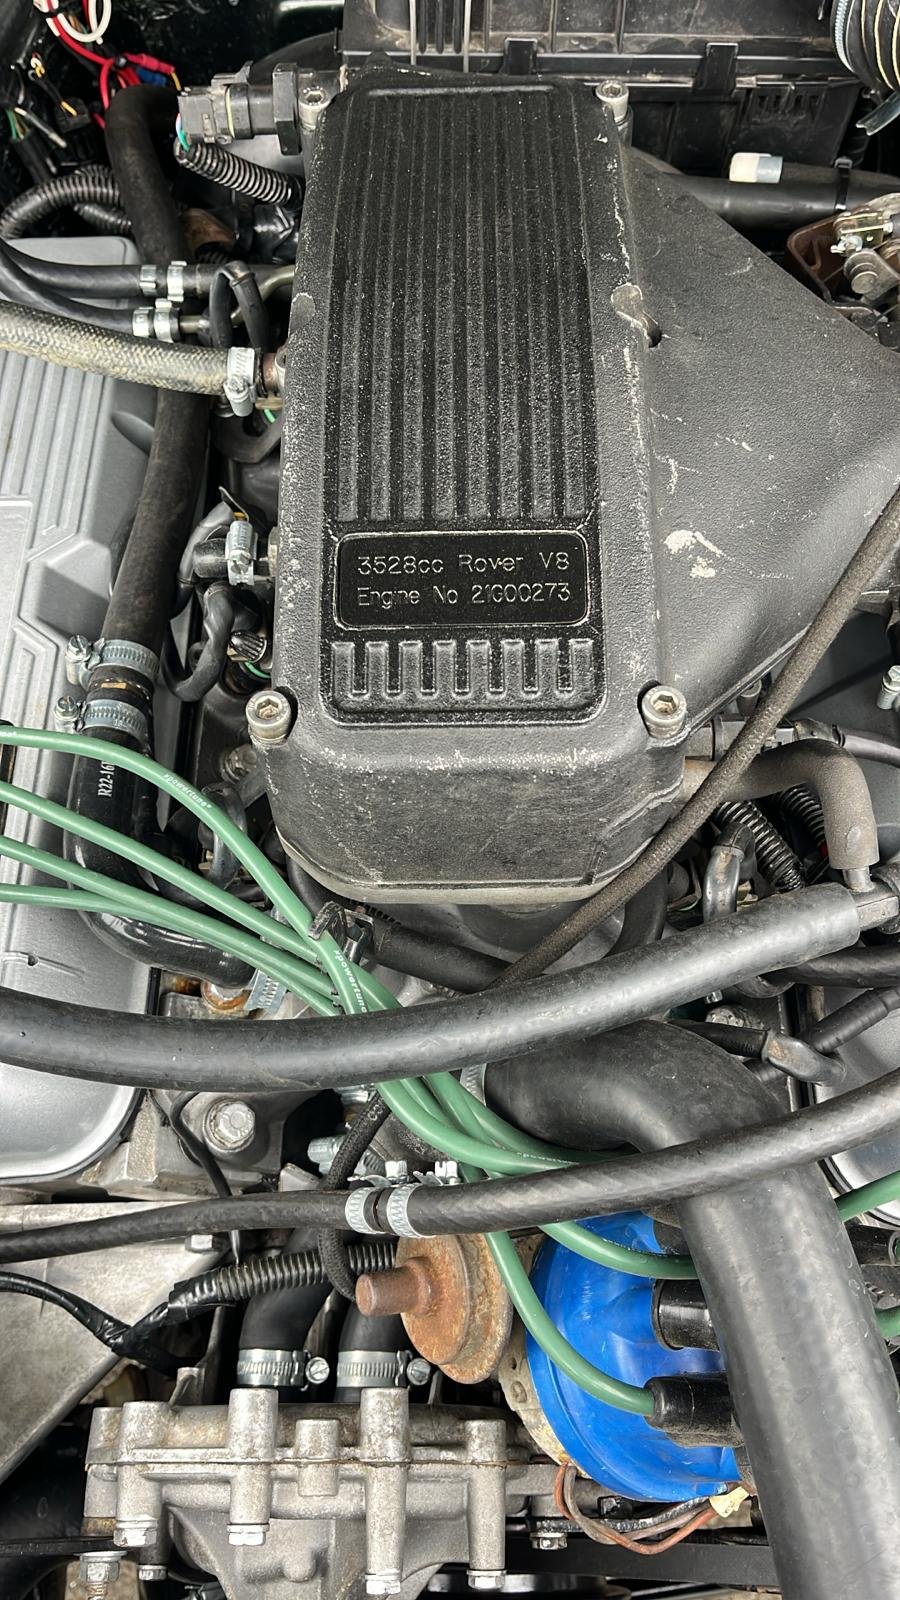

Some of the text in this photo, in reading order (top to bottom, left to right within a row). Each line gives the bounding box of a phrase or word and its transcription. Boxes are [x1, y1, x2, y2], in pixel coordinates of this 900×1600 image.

[357, 551, 570, 576] 3528cc Rover V8
[357, 586, 421, 609] Engine
[432, 585, 459, 604] No
